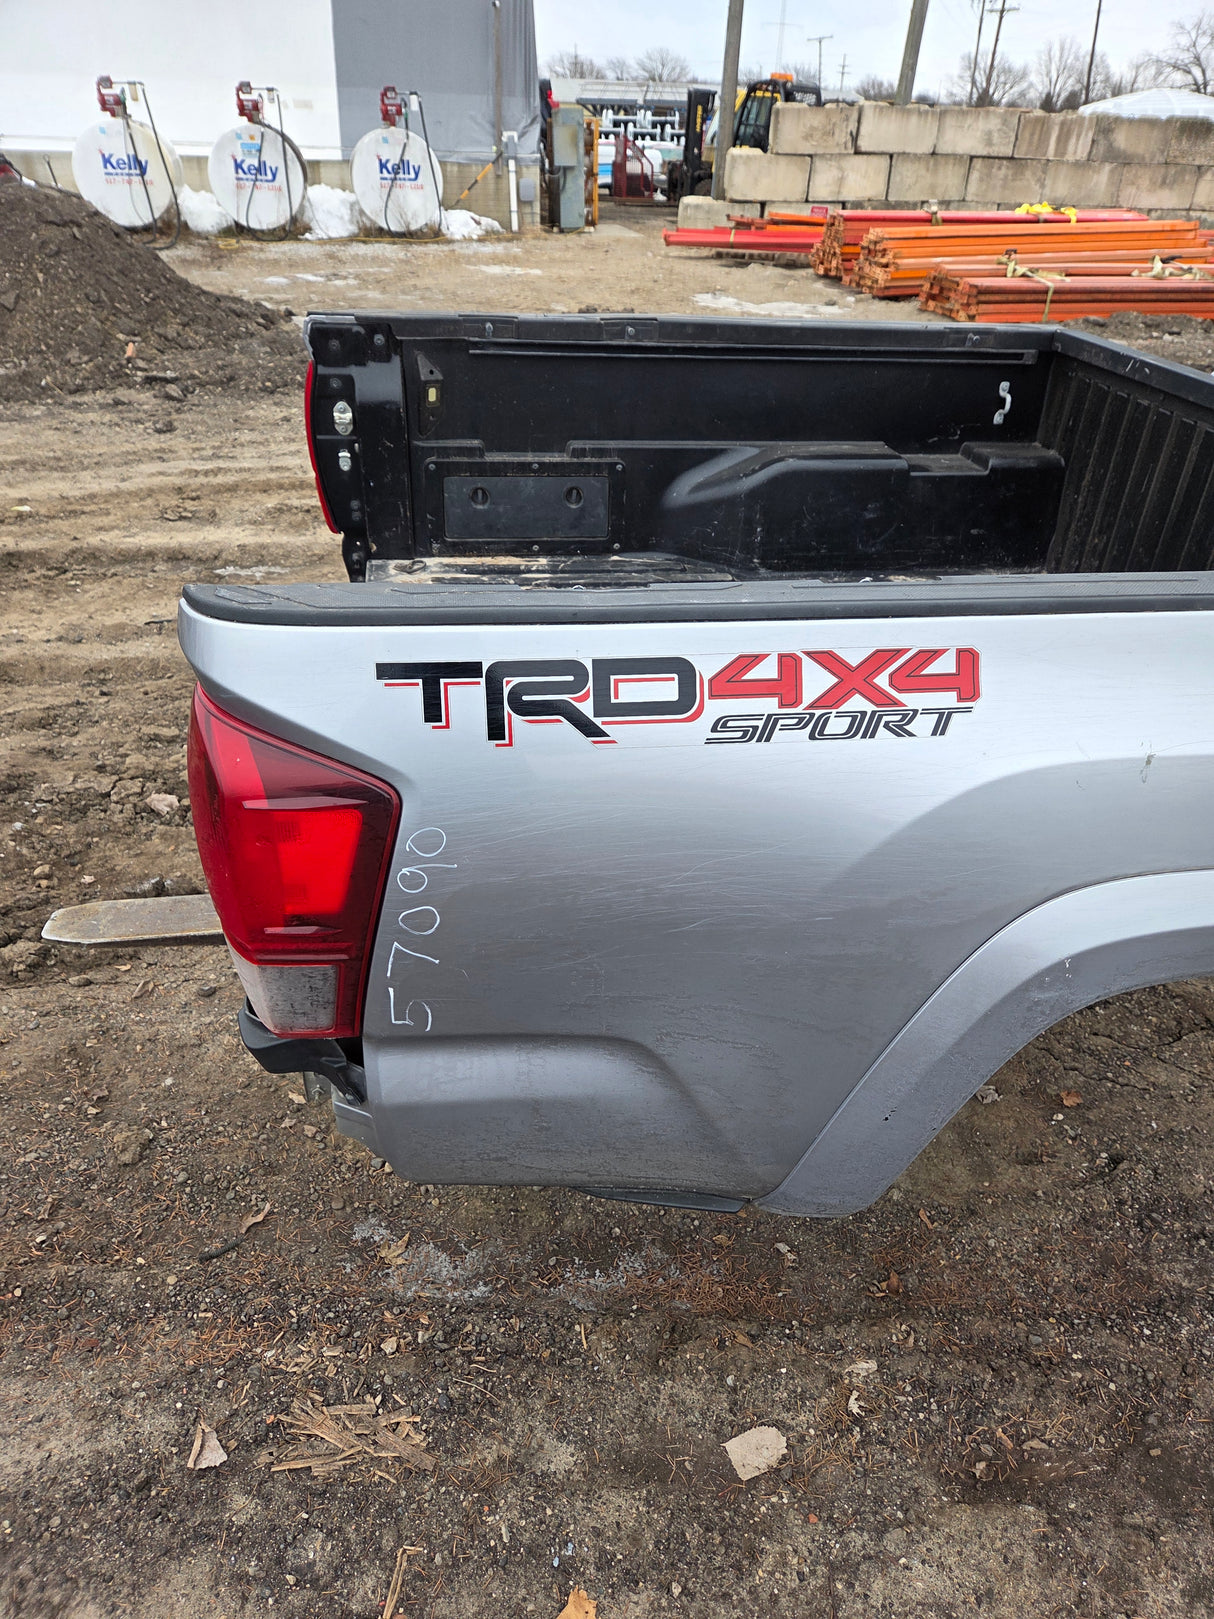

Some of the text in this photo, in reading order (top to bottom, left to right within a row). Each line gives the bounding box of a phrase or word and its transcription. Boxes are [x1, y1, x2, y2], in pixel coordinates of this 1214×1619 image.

[101, 153, 148, 177] Kelly
[233, 158, 278, 183] Kelly
[378, 158, 421, 181] Kelly
[376, 647, 981, 748] TRD 4X4
[704, 706, 975, 744] SPORT
[386, 826, 458, 1032] 57090
